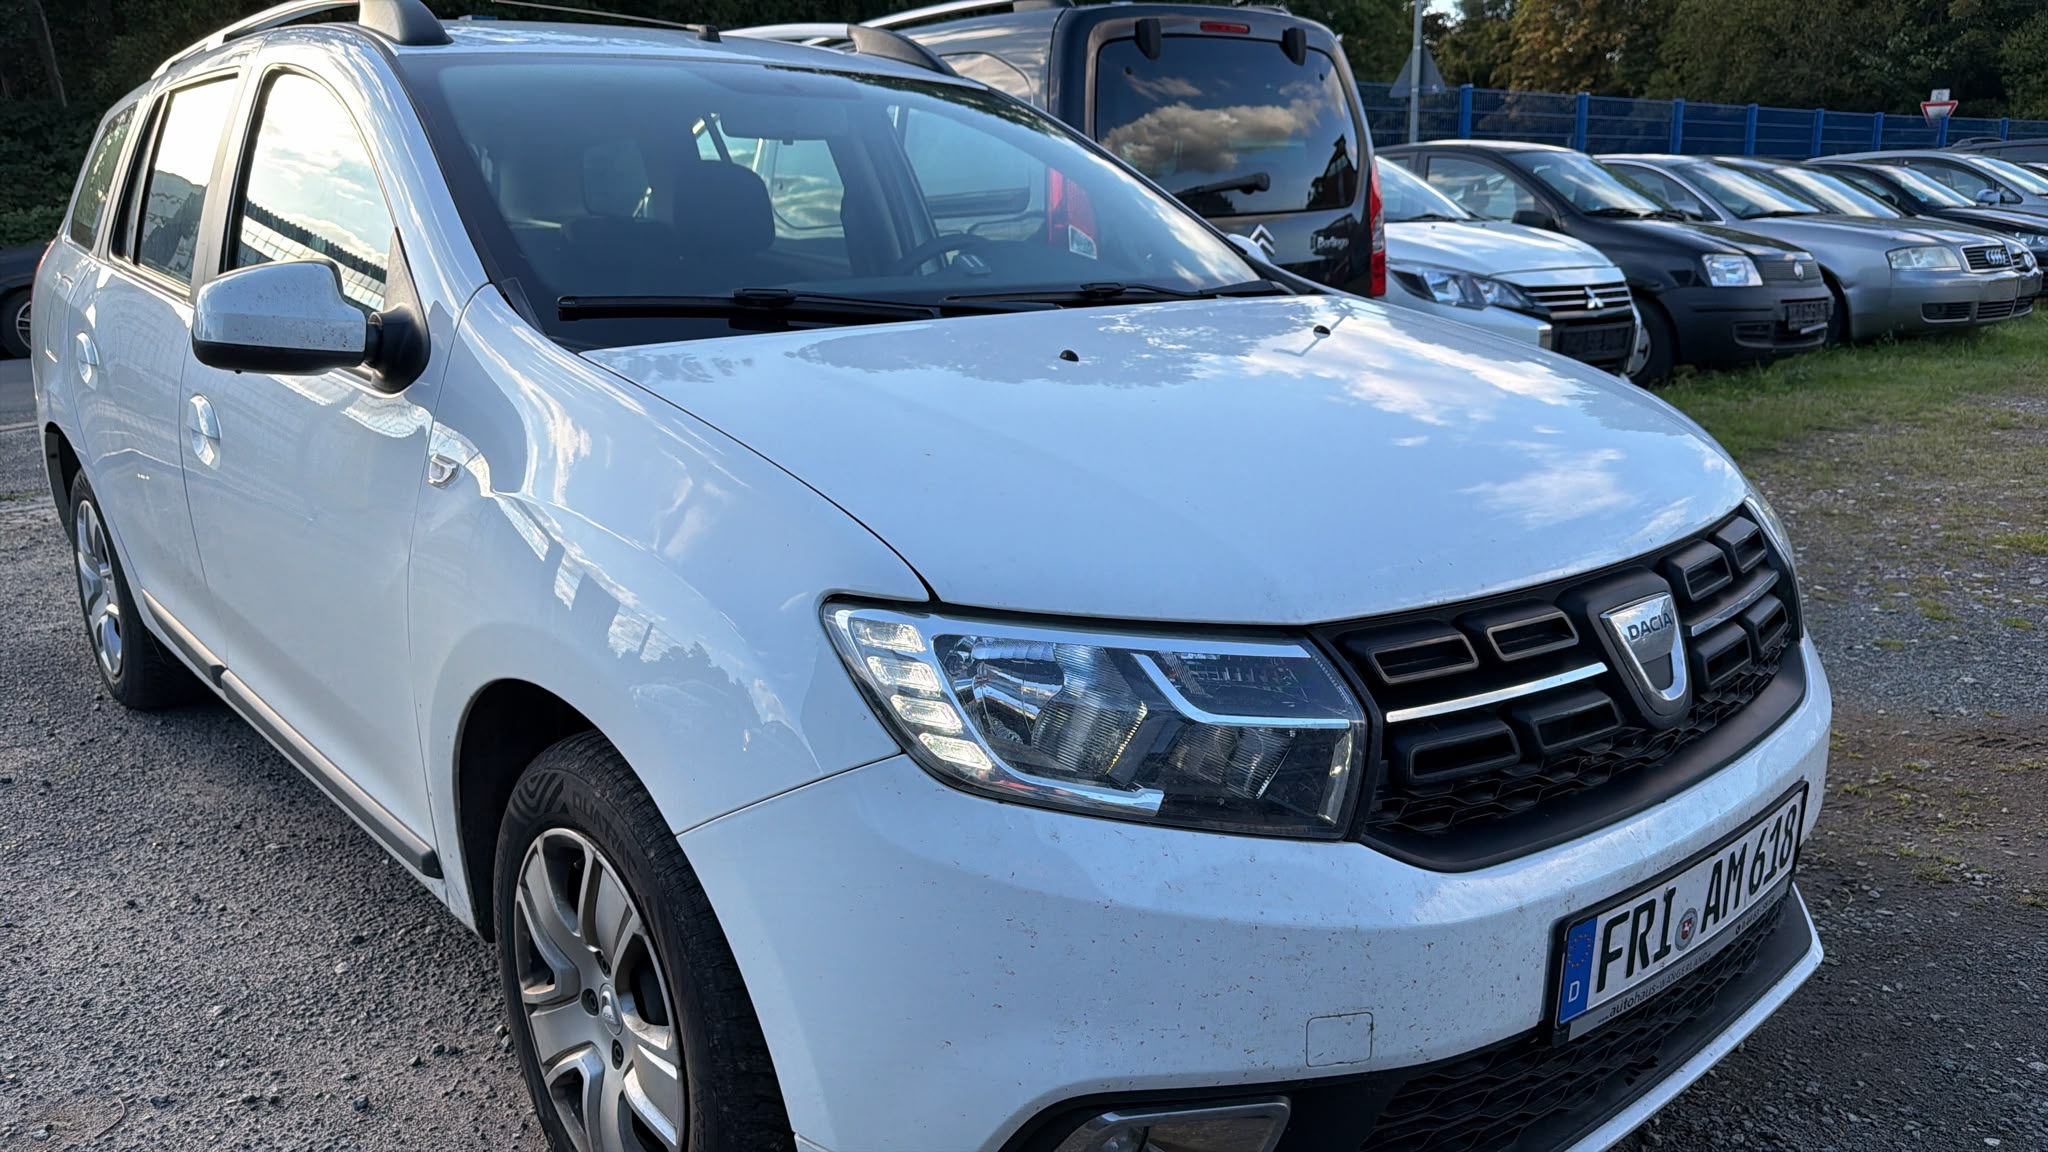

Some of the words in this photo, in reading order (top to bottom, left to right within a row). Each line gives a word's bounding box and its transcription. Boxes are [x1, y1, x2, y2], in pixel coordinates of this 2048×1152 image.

[1627, 613, 1673, 641] DACIA
[1567, 980, 1580, 1003] D
[1596, 887, 1676, 993] FRI
[1700, 842, 1748, 934] AM
[1748, 804, 1797, 896] 618
